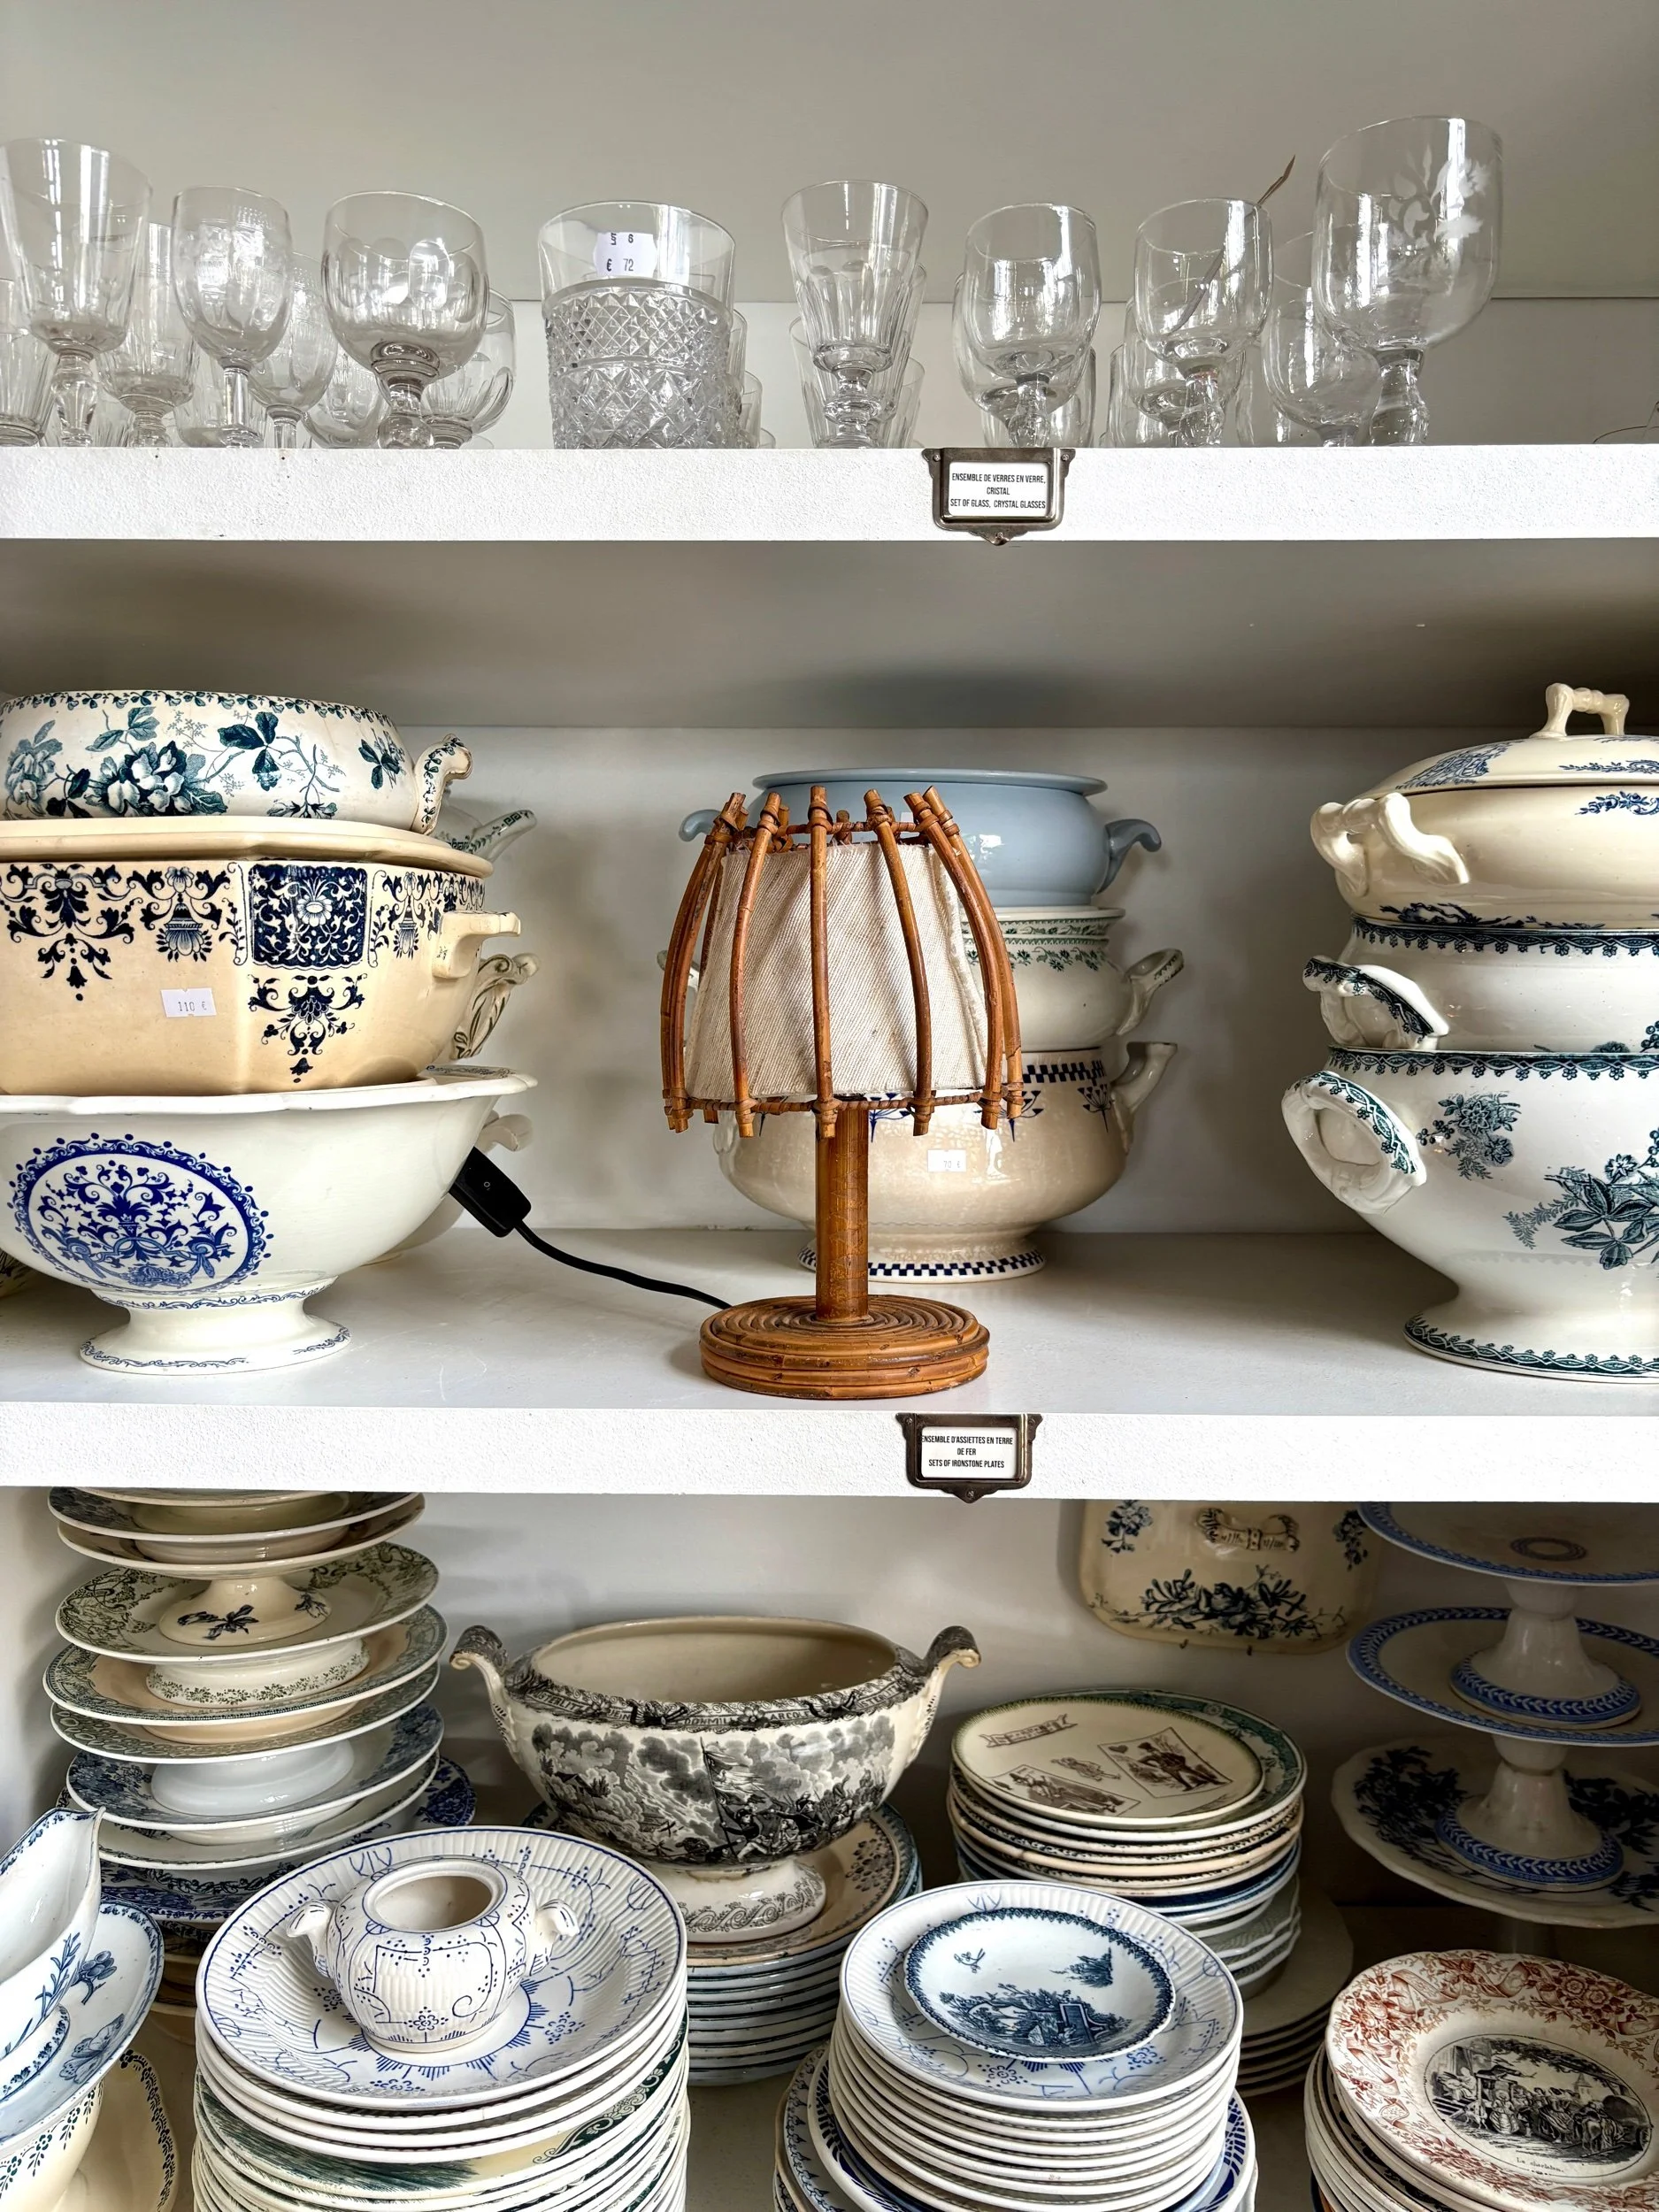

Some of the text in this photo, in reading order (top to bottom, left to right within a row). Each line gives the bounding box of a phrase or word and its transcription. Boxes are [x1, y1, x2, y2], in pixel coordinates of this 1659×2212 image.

[607, 258, 634, 272] € 72
[952, 472, 982, 482] ENSEMBLE
[993, 474, 1015, 483] VERRES
[1016, 474, 1024, 483] EN
[1025, 475, 1046, 484] VERRE,
[987, 487, 1010, 495] CRISTAL
[950, 498, 961, 507] SET
[971, 499, 991, 509] GLASS,
[994, 500, 1018, 509] CRYSTAL
[1020, 500, 1046, 509] GLASSES
[178, 1001, 196, 1012] 110
[984, 1460, 1005, 1469] PLATES
